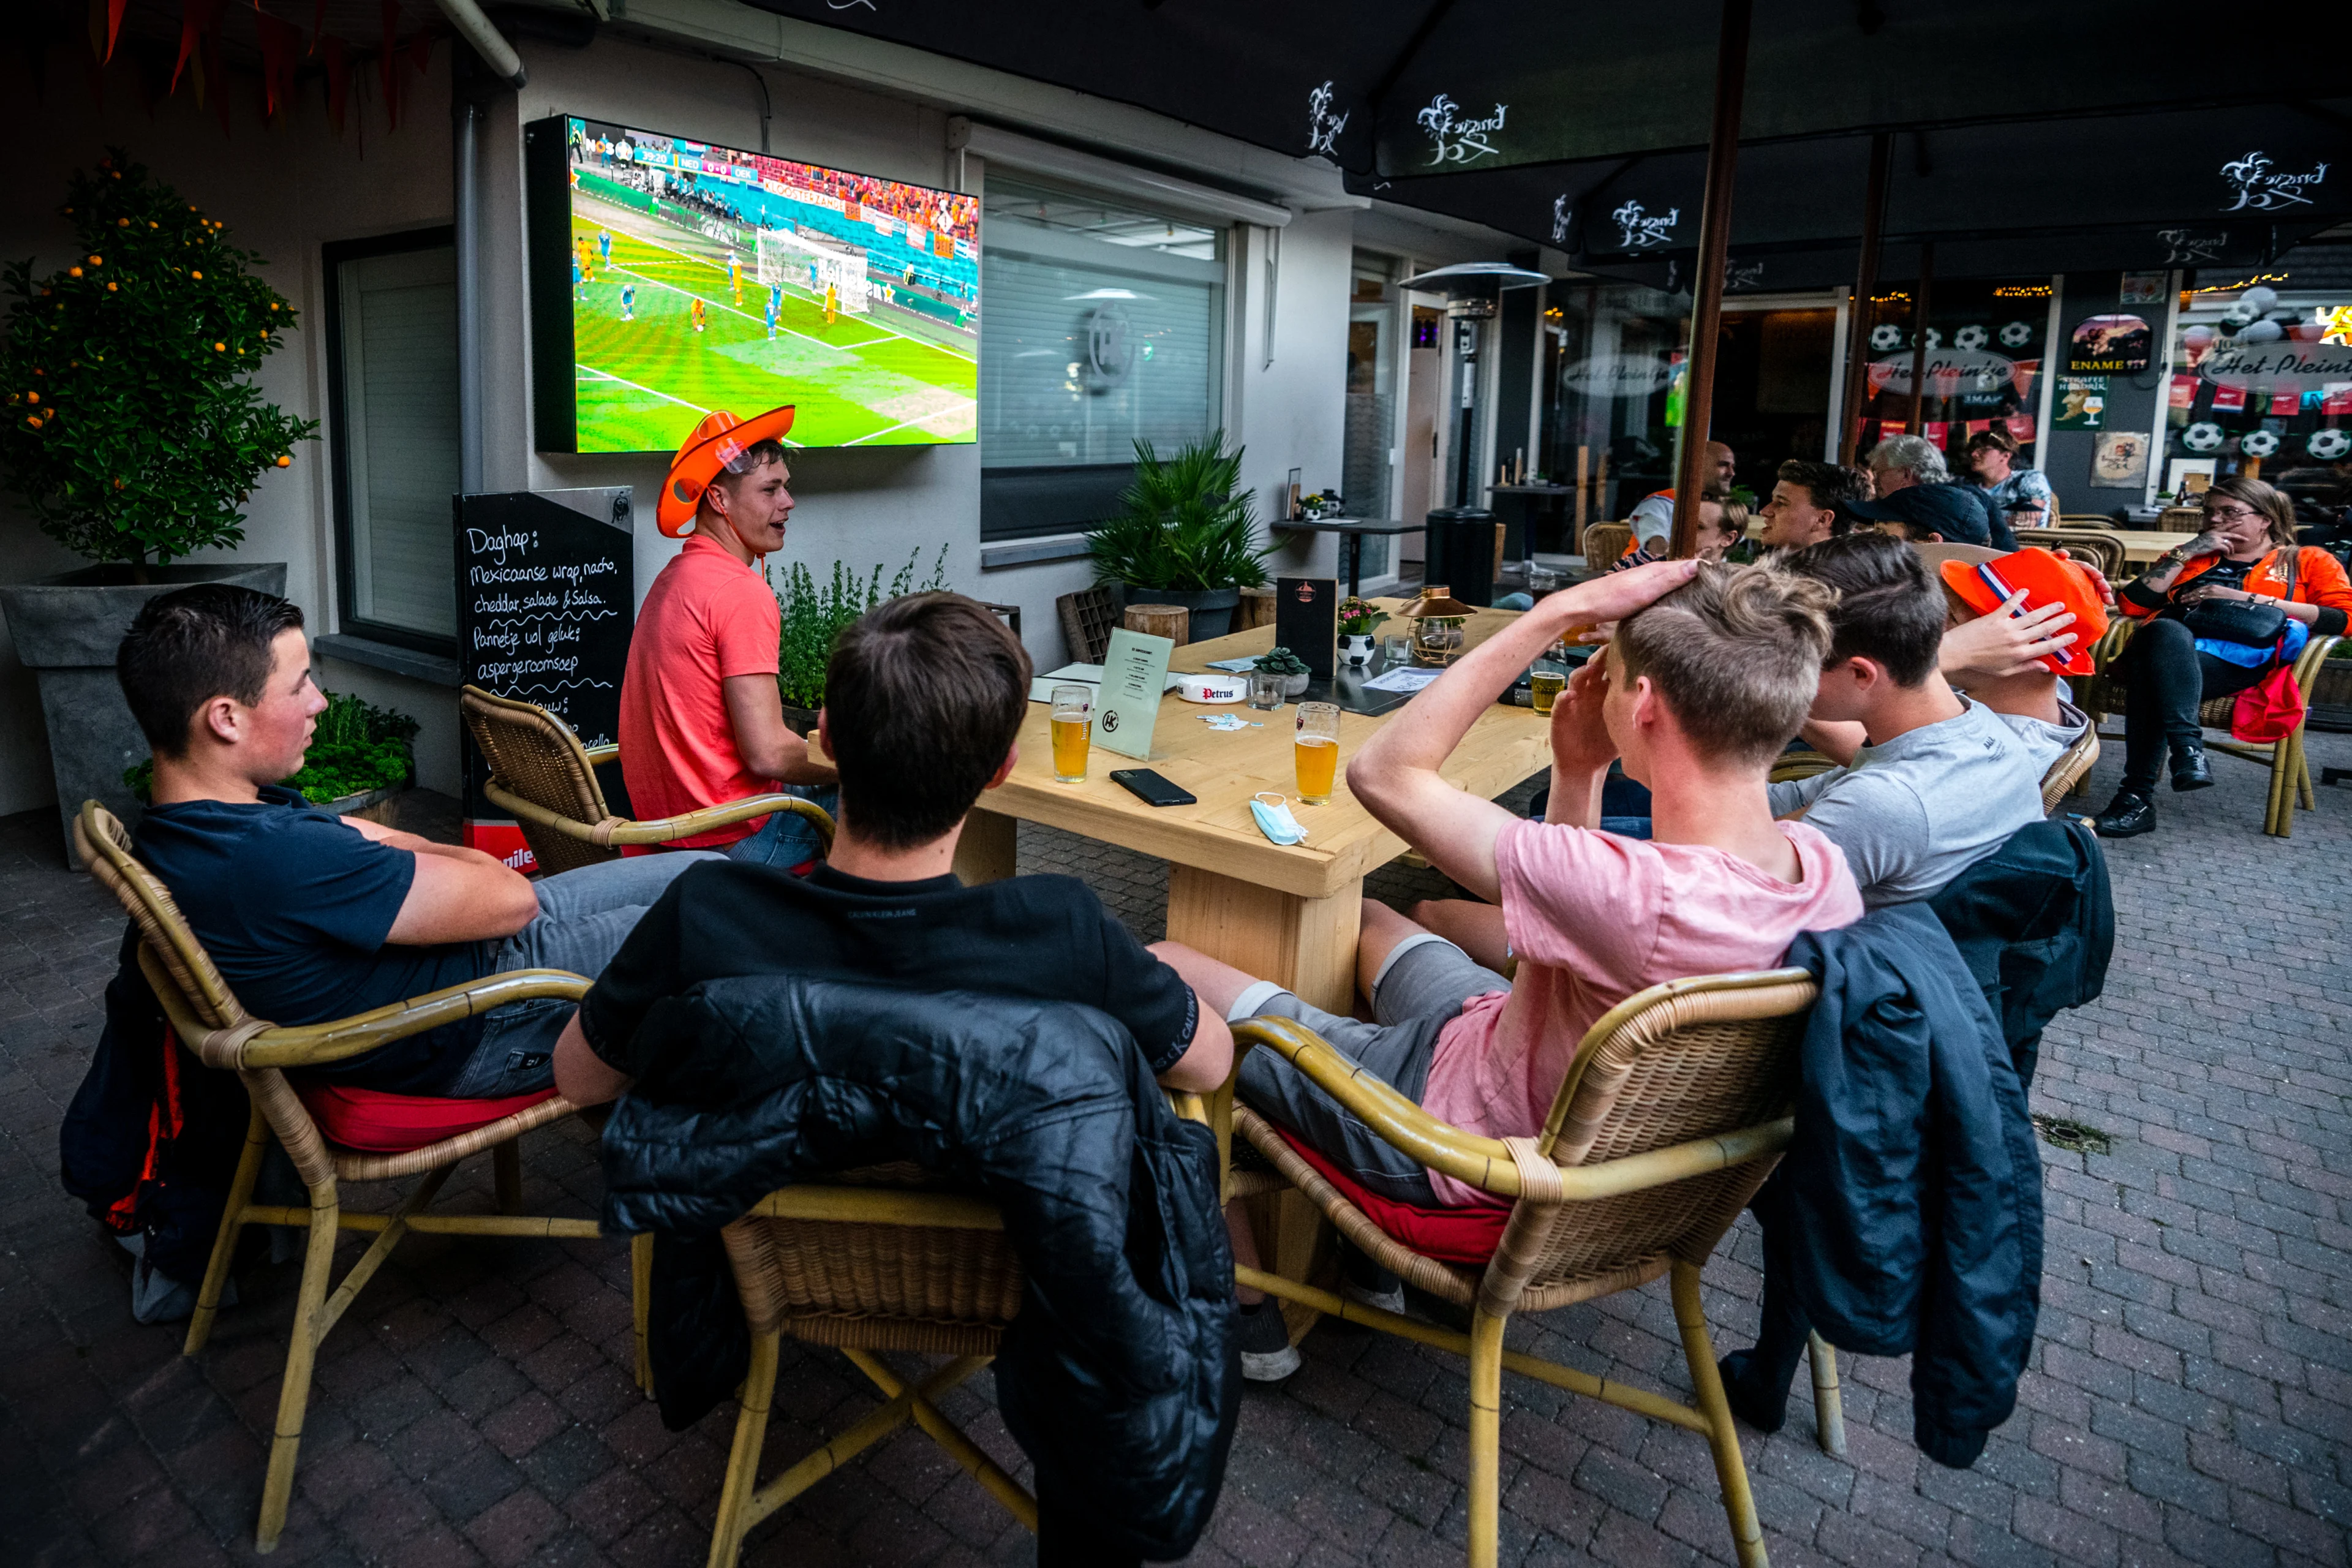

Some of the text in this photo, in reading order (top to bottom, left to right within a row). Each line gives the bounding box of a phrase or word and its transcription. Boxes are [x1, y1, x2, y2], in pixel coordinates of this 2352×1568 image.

[586, 138, 614, 156] NOS
[643, 151, 667, 164] 39:20
[681, 157, 699, 170] NED
[735, 168, 752, 179] OEK
[2071, 360, 2125, 371] ENAME
[2211, 354, 2352, 377] Het-Pleint
[470, 565, 549, 586] Mexicaanse
[474, 626, 521, 656] Pannetje
[525, 624, 541, 646] vol
[478, 656, 578, 684] aspergeroomsoep
[1202, 688, 1234, 699] Petrus
